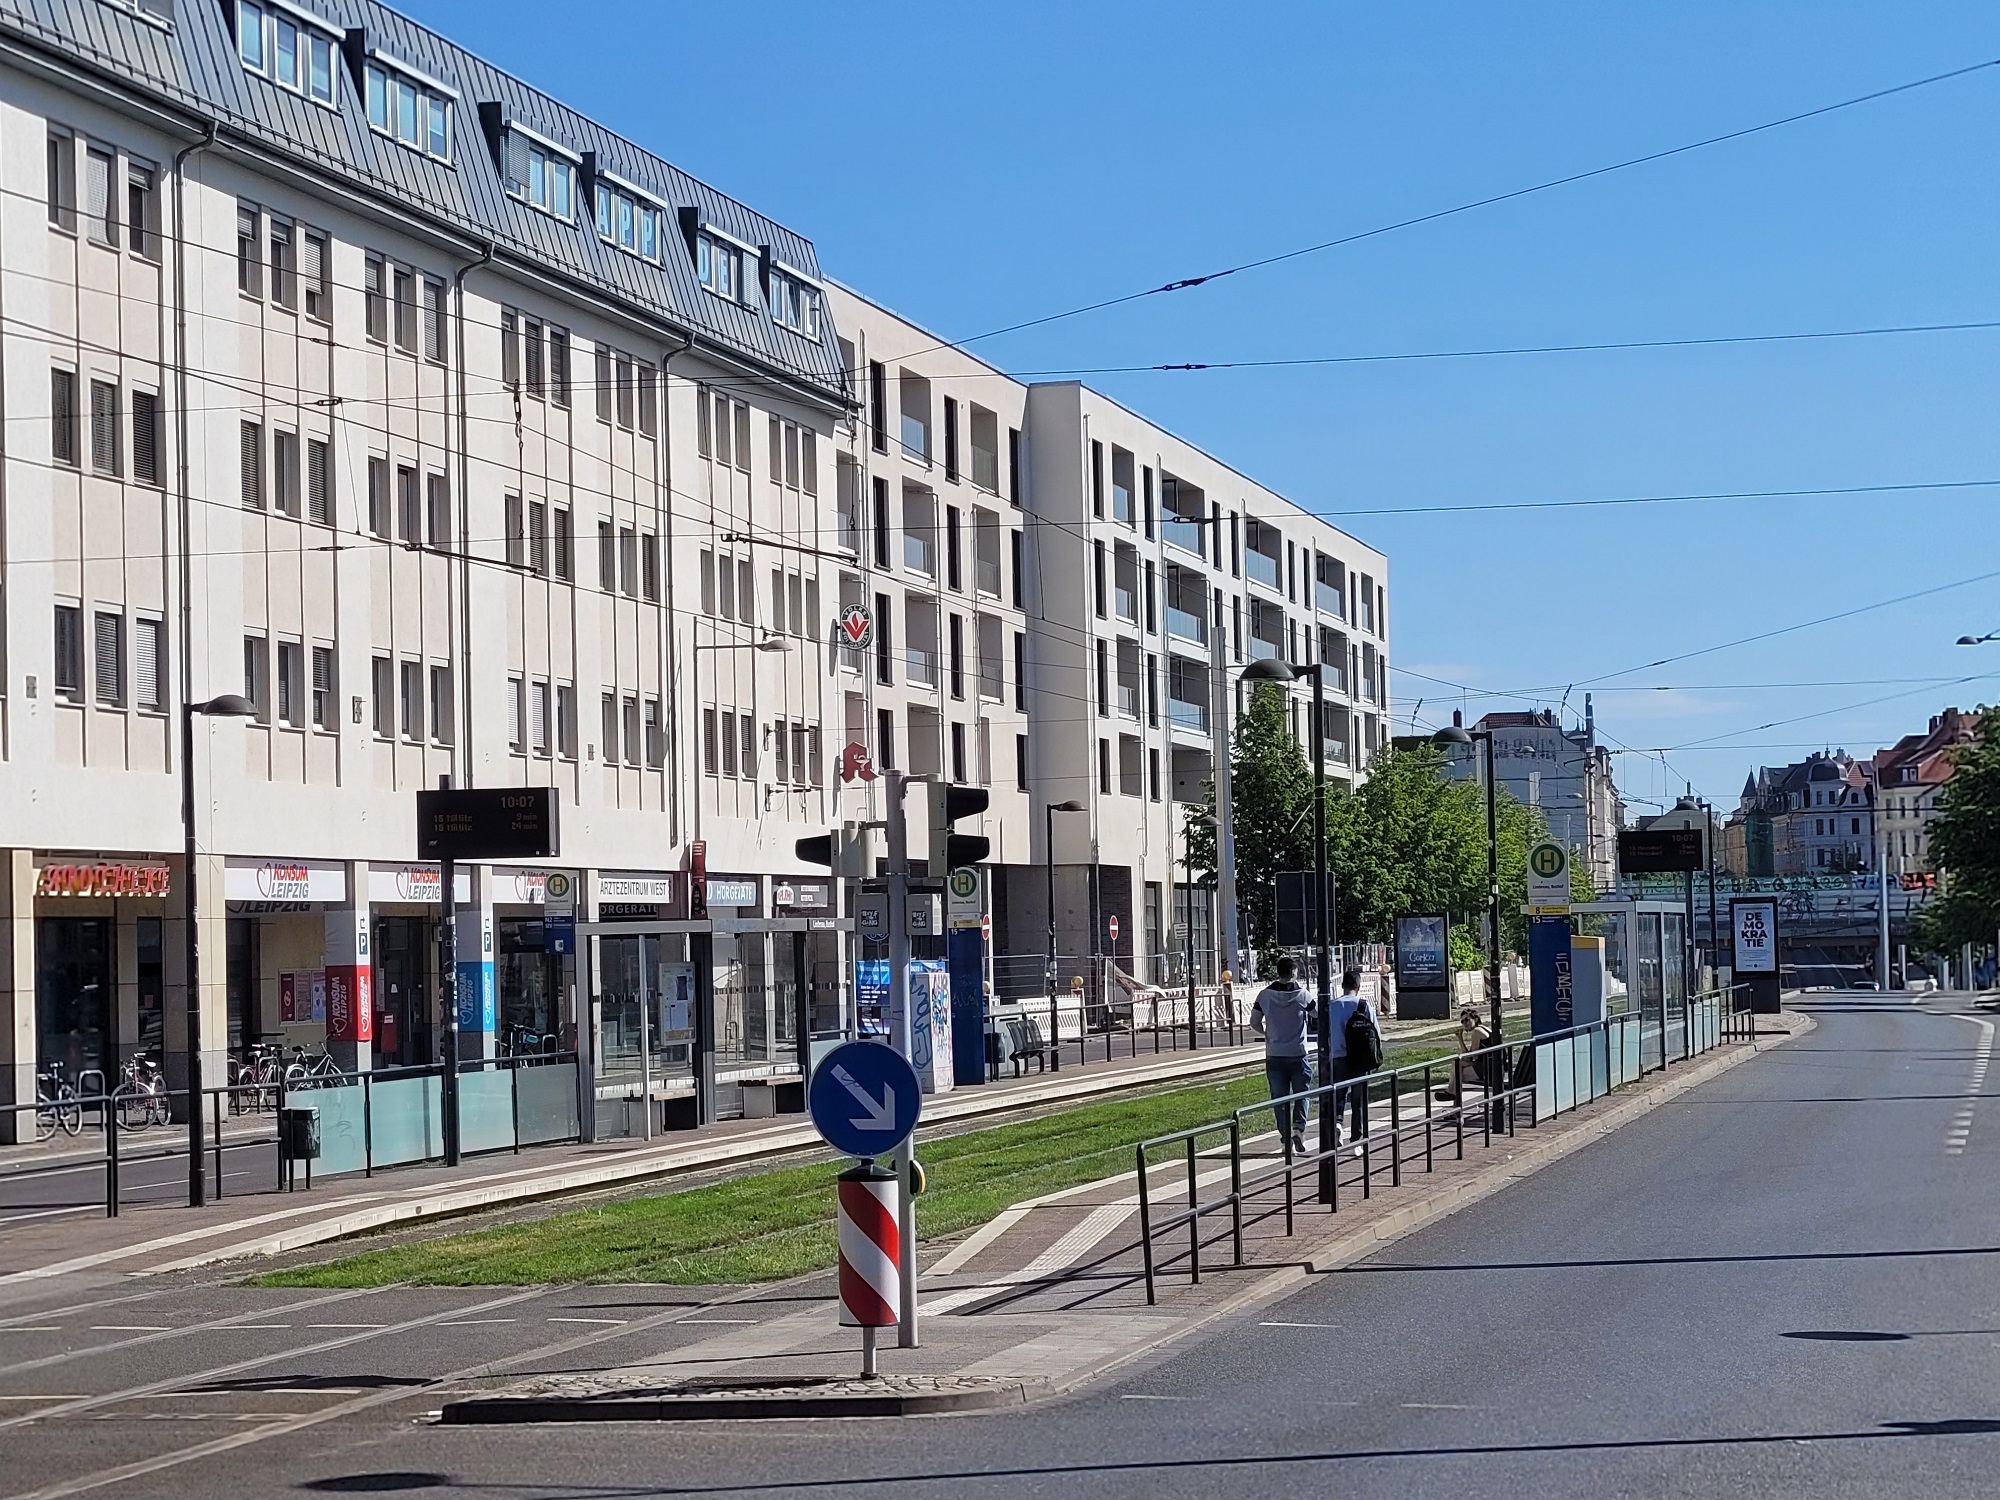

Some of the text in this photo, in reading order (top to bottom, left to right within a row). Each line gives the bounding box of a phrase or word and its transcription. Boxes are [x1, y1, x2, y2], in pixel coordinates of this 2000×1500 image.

[500, 796, 535, 808] 10:07
[511, 822, 522, 830] 24
[1672, 834, 1694, 842] 10:07
[1541, 852, 1554, 870] H
[42, 863, 170, 894] APOTHEKE
[273, 863, 309, 882] KONSUM
[410, 867, 440, 885] KONSUM
[553, 878, 563, 892] H
[650, 882, 667, 896] WEST
[958, 875, 969, 891] H
[271, 882, 309, 899] LEIPZIG
[408, 885, 440, 900] LEIPZIG
[1535, 906, 1541, 914] 8
[1745, 912, 1763, 921] DE
[1531, 915, 1541, 924] 15
[1743, 921, 1765, 930] MO
[1741, 930, 1768, 939] KRA
[1744, 939, 1764, 948] TIE
[331, 976, 340, 1017] KONSUM
[459, 972, 467, 1010] KONSUM
